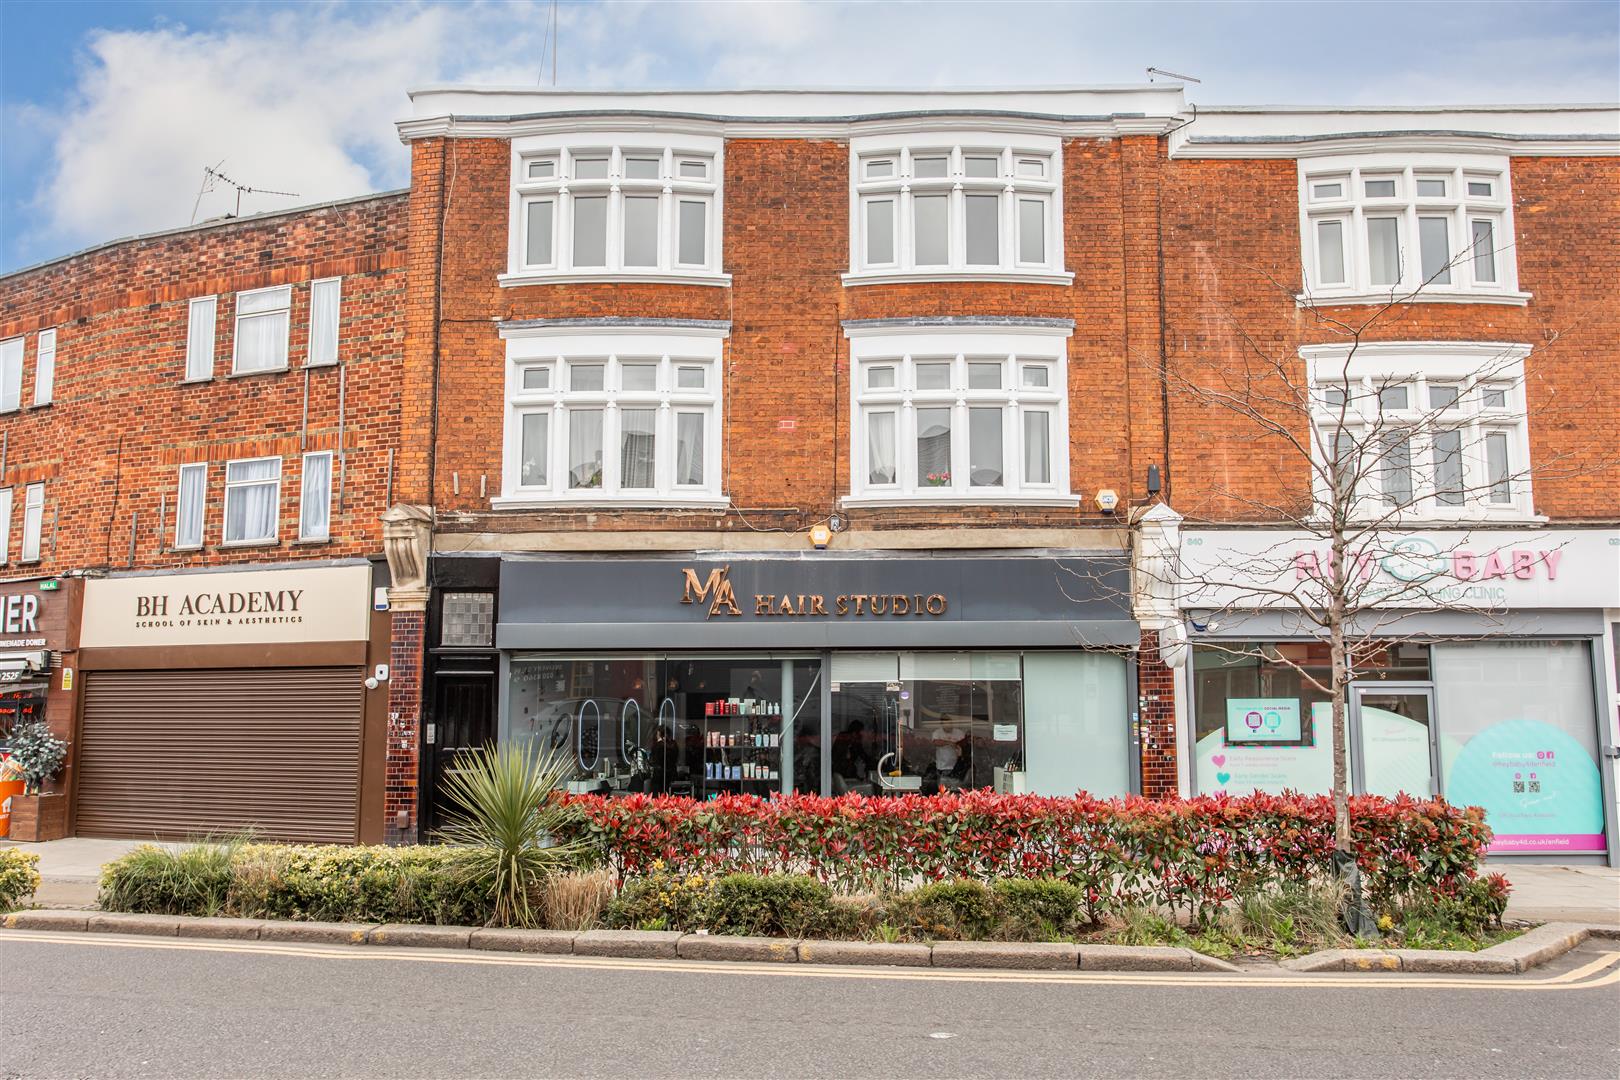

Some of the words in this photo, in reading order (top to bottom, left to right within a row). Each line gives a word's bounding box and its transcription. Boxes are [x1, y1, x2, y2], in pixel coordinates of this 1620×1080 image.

[1453, 550, 1562, 580] BABY
[136, 596, 168, 617] BH
[179, 590, 304, 615] ACADEMY
[1465, 587, 1505, 600] CLINIC
[0, 594, 38, 632] ER
[754, 594, 828, 615] HAIR
[836, 594, 948, 615] STUDIO
[239, 616, 302, 625] AESTHETICS
[26, 638, 46, 646] DONER
